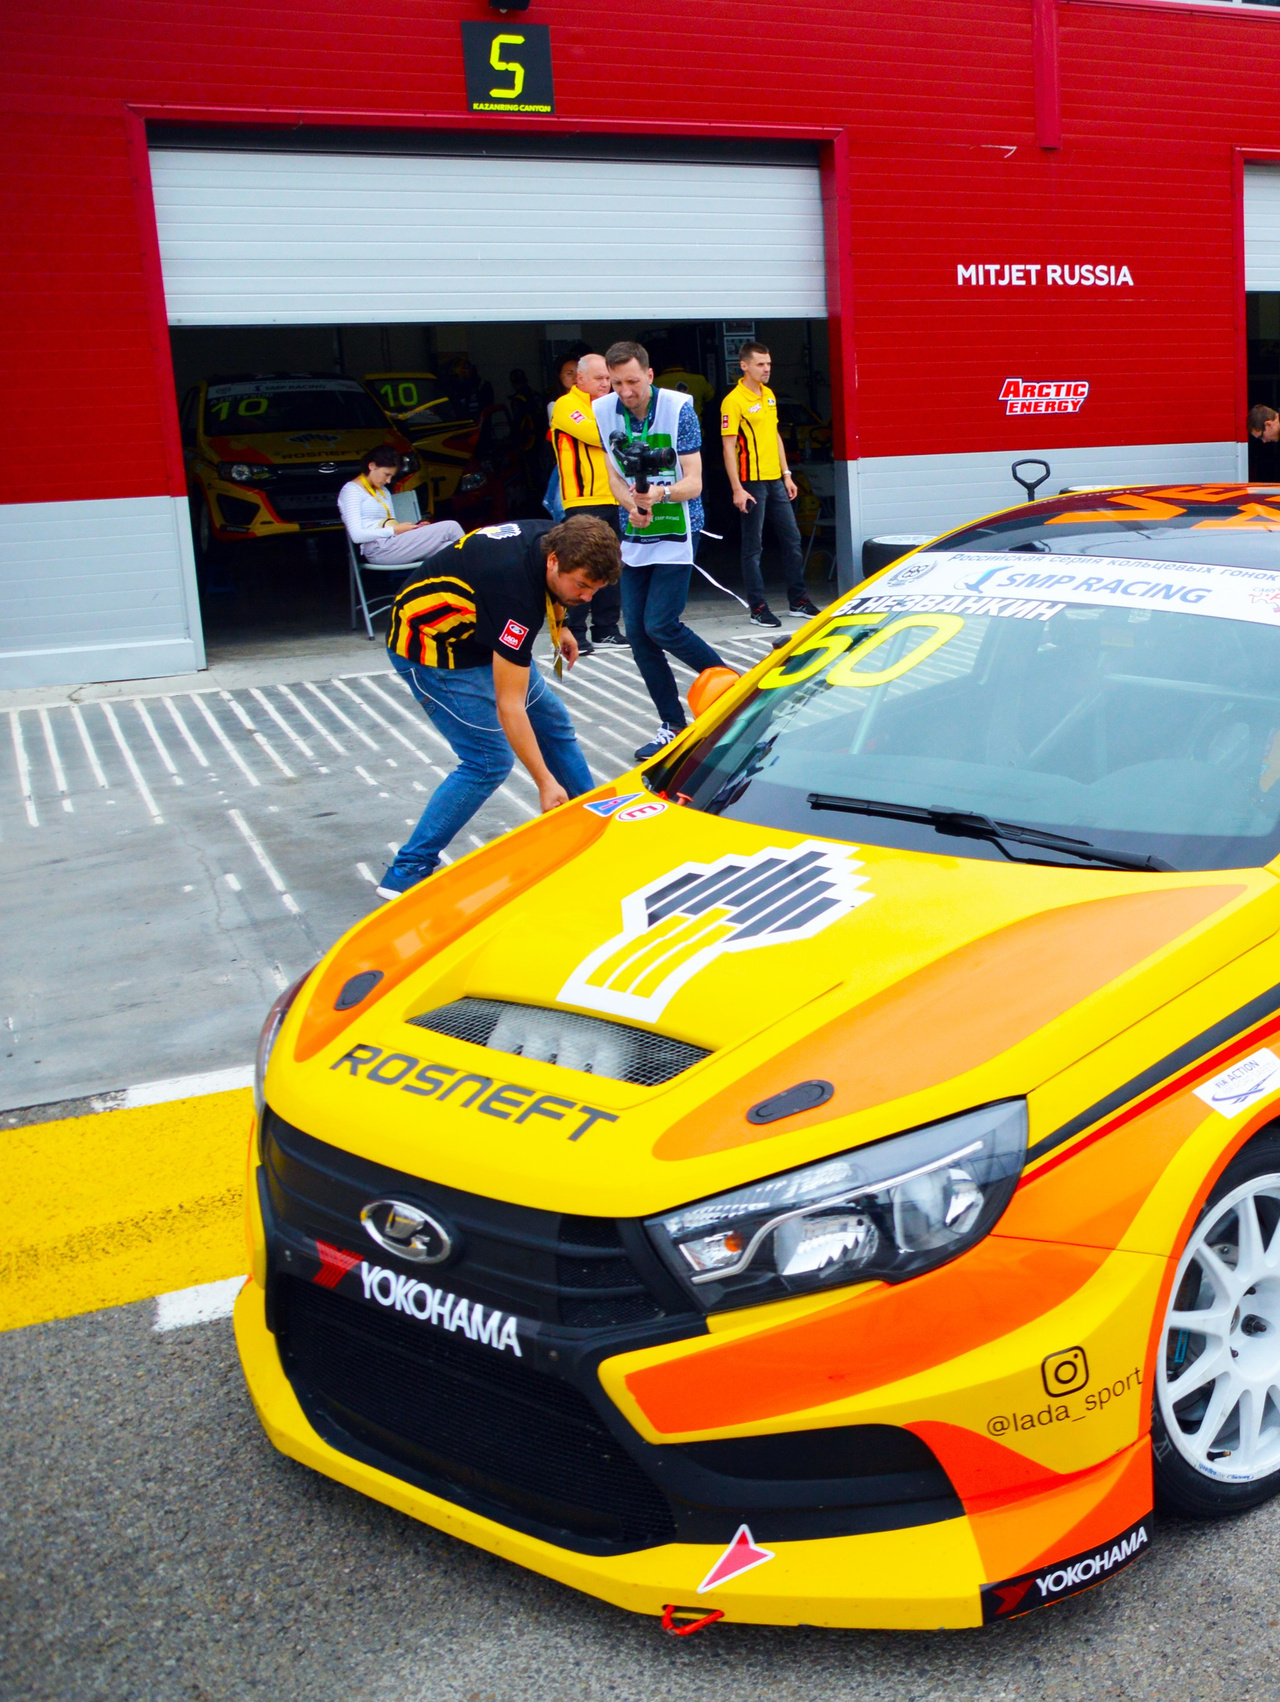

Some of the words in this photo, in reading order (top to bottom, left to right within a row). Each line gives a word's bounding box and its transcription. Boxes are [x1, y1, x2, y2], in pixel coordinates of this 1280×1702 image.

[489, 34, 525, 99] 5
[472, 102, 519, 111] KAZANRING
[957, 264, 1041, 286] MITJET
[1046, 264, 1134, 286] RUSSIA
[380, 382, 419, 408] 10
[1007, 399, 1084, 415] ENERGY
[210, 397, 269, 422] 10
[947, 554, 1048, 563] Российская
[1049, 555, 1103, 566] серия
[1107, 558, 1216, 575] кольцевых
[1219, 568, 1280, 582] гонок
[995, 573, 1077, 590] SMP
[1072, 575, 1214, 604] RACING
[832, 596, 1067, 622] В.НЕЗВАНКИН
[758, 613, 966, 690] 50
[625, 805, 658, 819] E
[1227, 1059, 1259, 1082] ACTION
[329, 1043, 621, 1142] ROSNEFT
[361, 1261, 523, 1358] YOKOHAMA
[986, 1367, 1143, 1437] @lada_sport
[1035, 1526, 1149, 1597] YOKOHAMA
